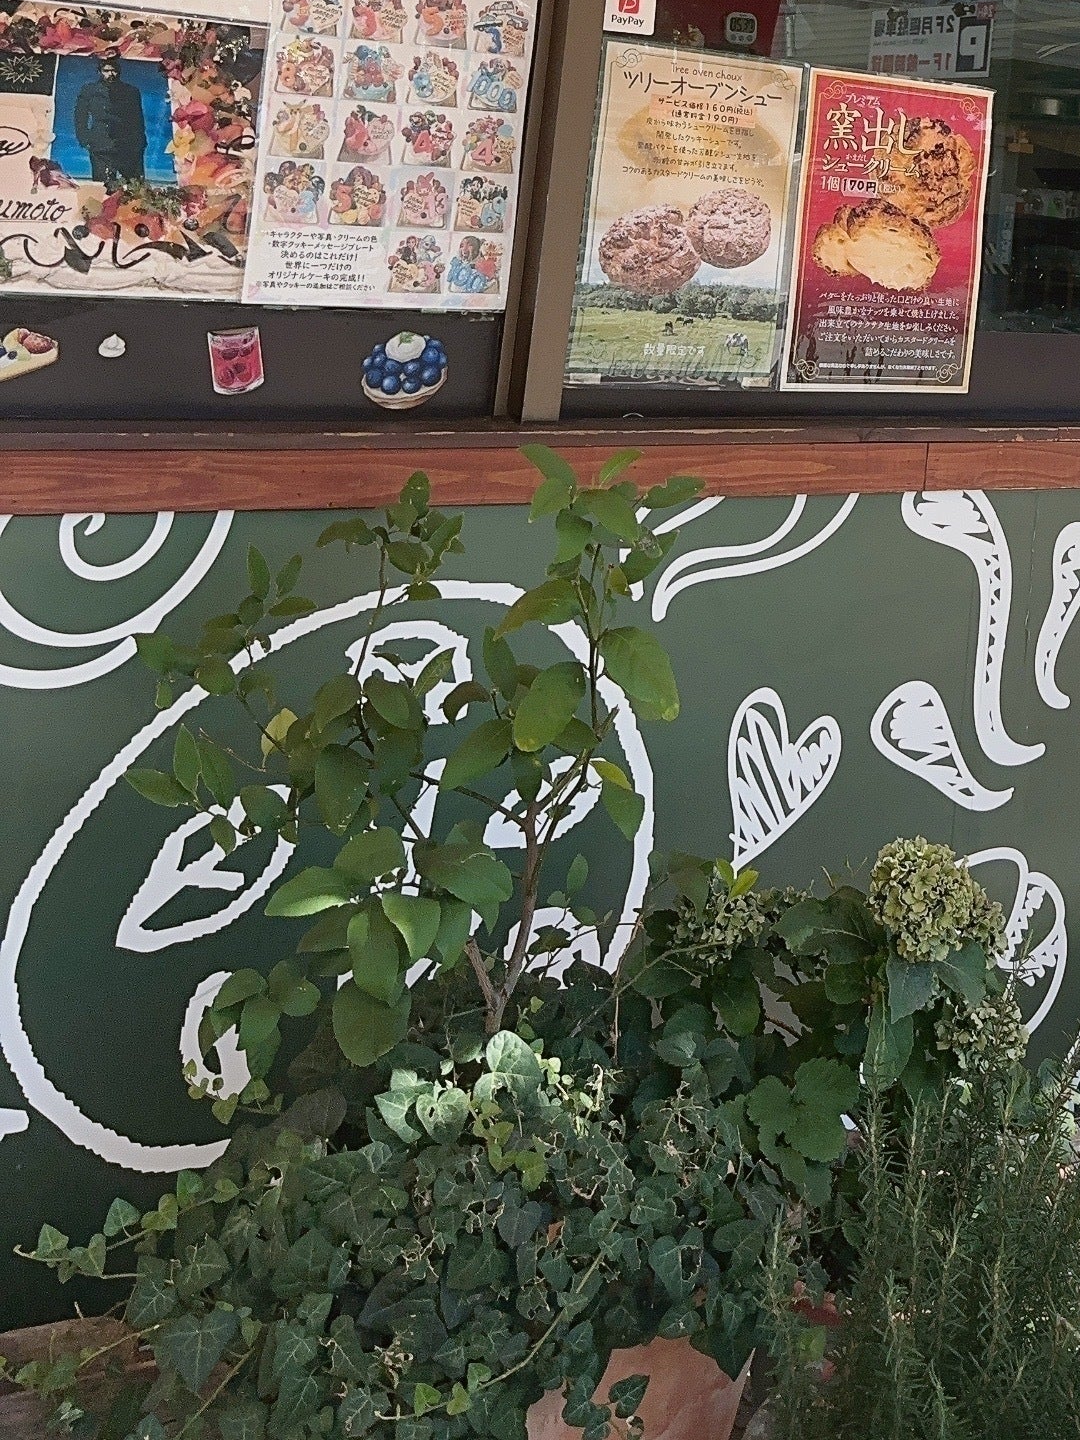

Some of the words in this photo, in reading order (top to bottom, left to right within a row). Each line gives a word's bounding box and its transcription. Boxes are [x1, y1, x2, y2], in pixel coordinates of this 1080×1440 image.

[611, 14, 645, 28] PayPay
[671, 62, 689, 74] Tree
[693, 68, 713, 78] oven
[715, 71, 742, 81] choux
[623, 71, 782, 107] ツリーオーブンシュー
[845, 93, 881, 108] プレミアム
[823, 102, 925, 156] 窯出し
[822, 155, 921, 178] シュークリーム
[285, 261, 352, 271] 世界に一つだけの
[643, 343, 706, 358] 数量限定です
